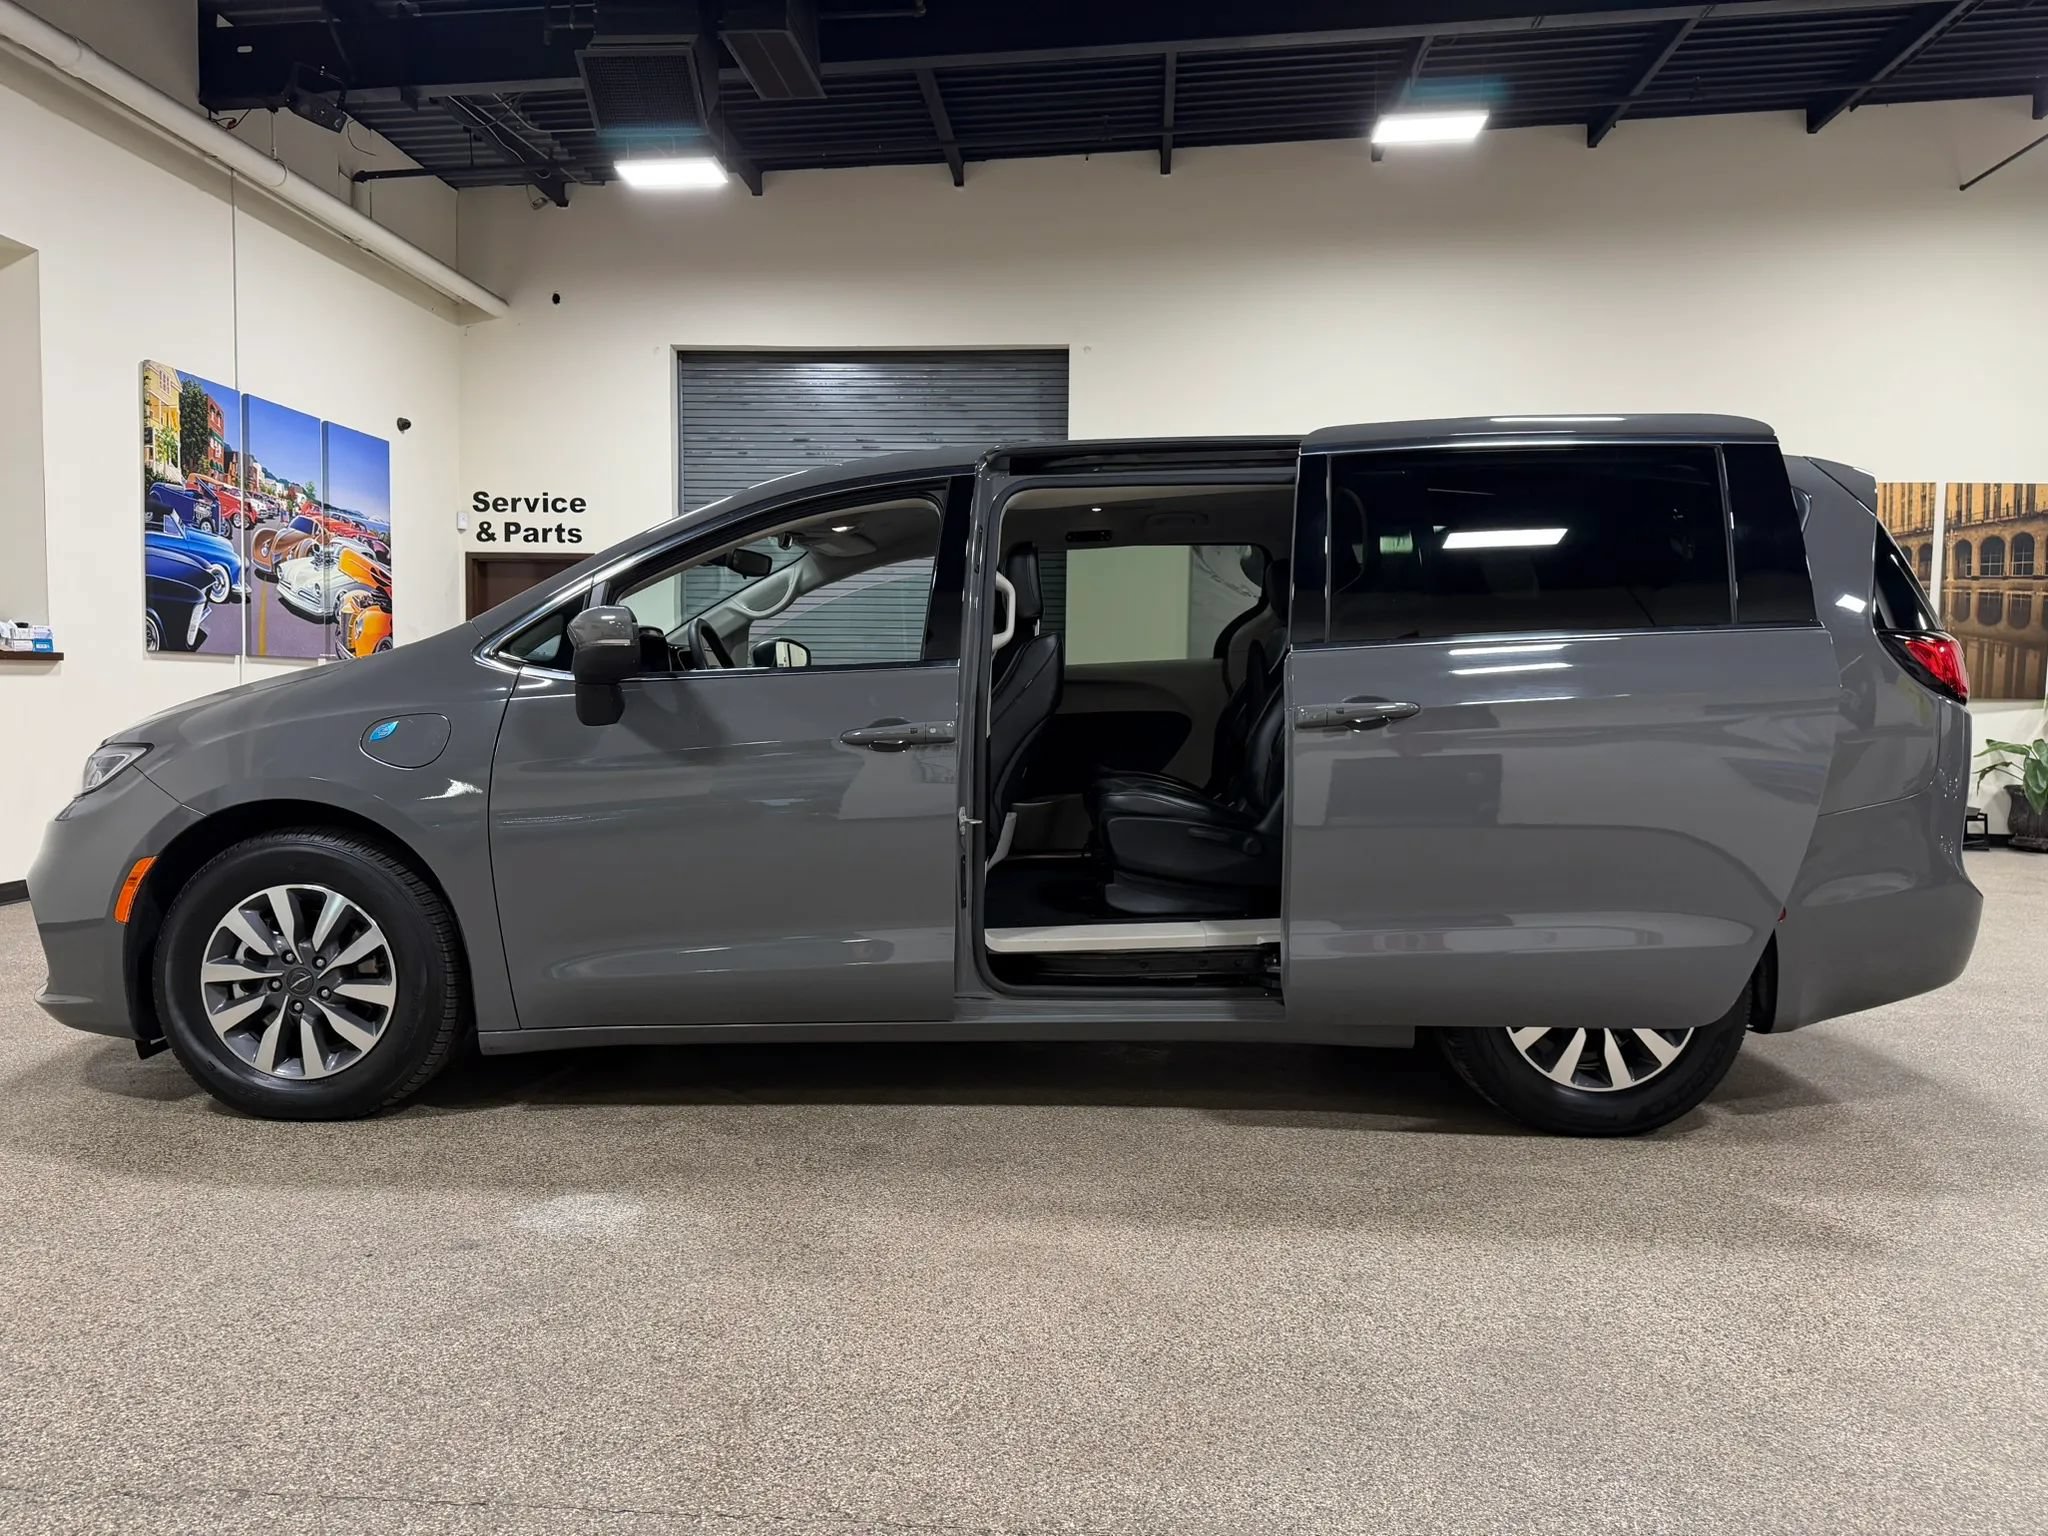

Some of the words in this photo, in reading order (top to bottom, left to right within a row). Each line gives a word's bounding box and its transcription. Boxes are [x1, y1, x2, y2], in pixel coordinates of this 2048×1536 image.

[472, 491, 587, 513] Service
[476, 521, 497, 543] &
[504, 521, 583, 543] Parts
